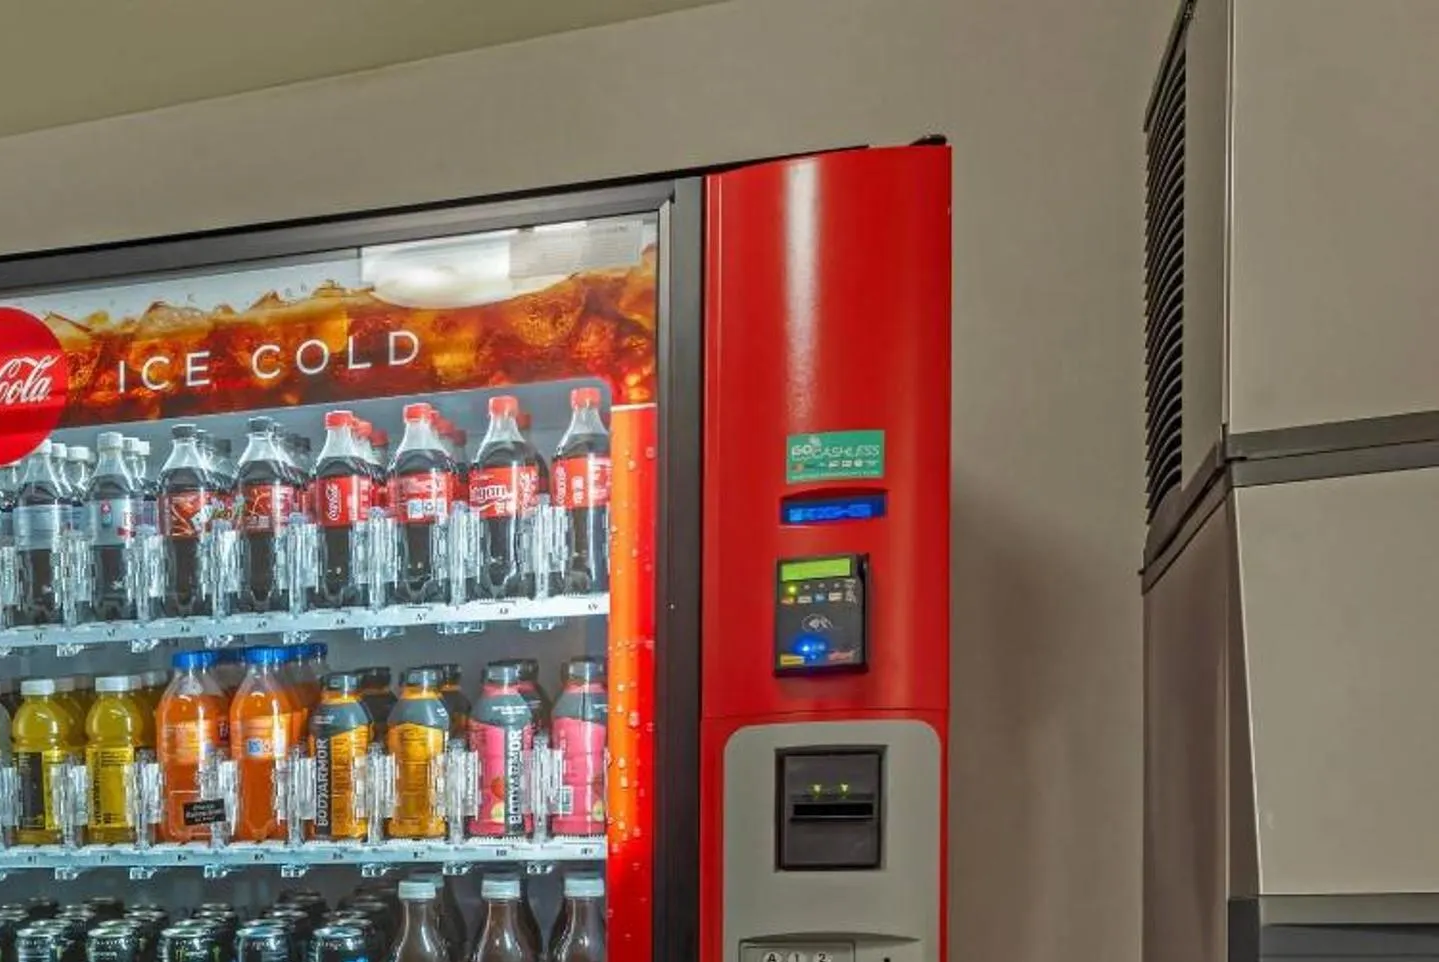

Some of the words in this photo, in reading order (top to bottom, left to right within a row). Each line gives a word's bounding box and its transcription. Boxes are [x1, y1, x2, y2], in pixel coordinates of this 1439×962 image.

[117, 354, 209, 394] ICE
[251, 331, 421, 380] COLD
[316, 737, 331, 828] BODYARMOR
